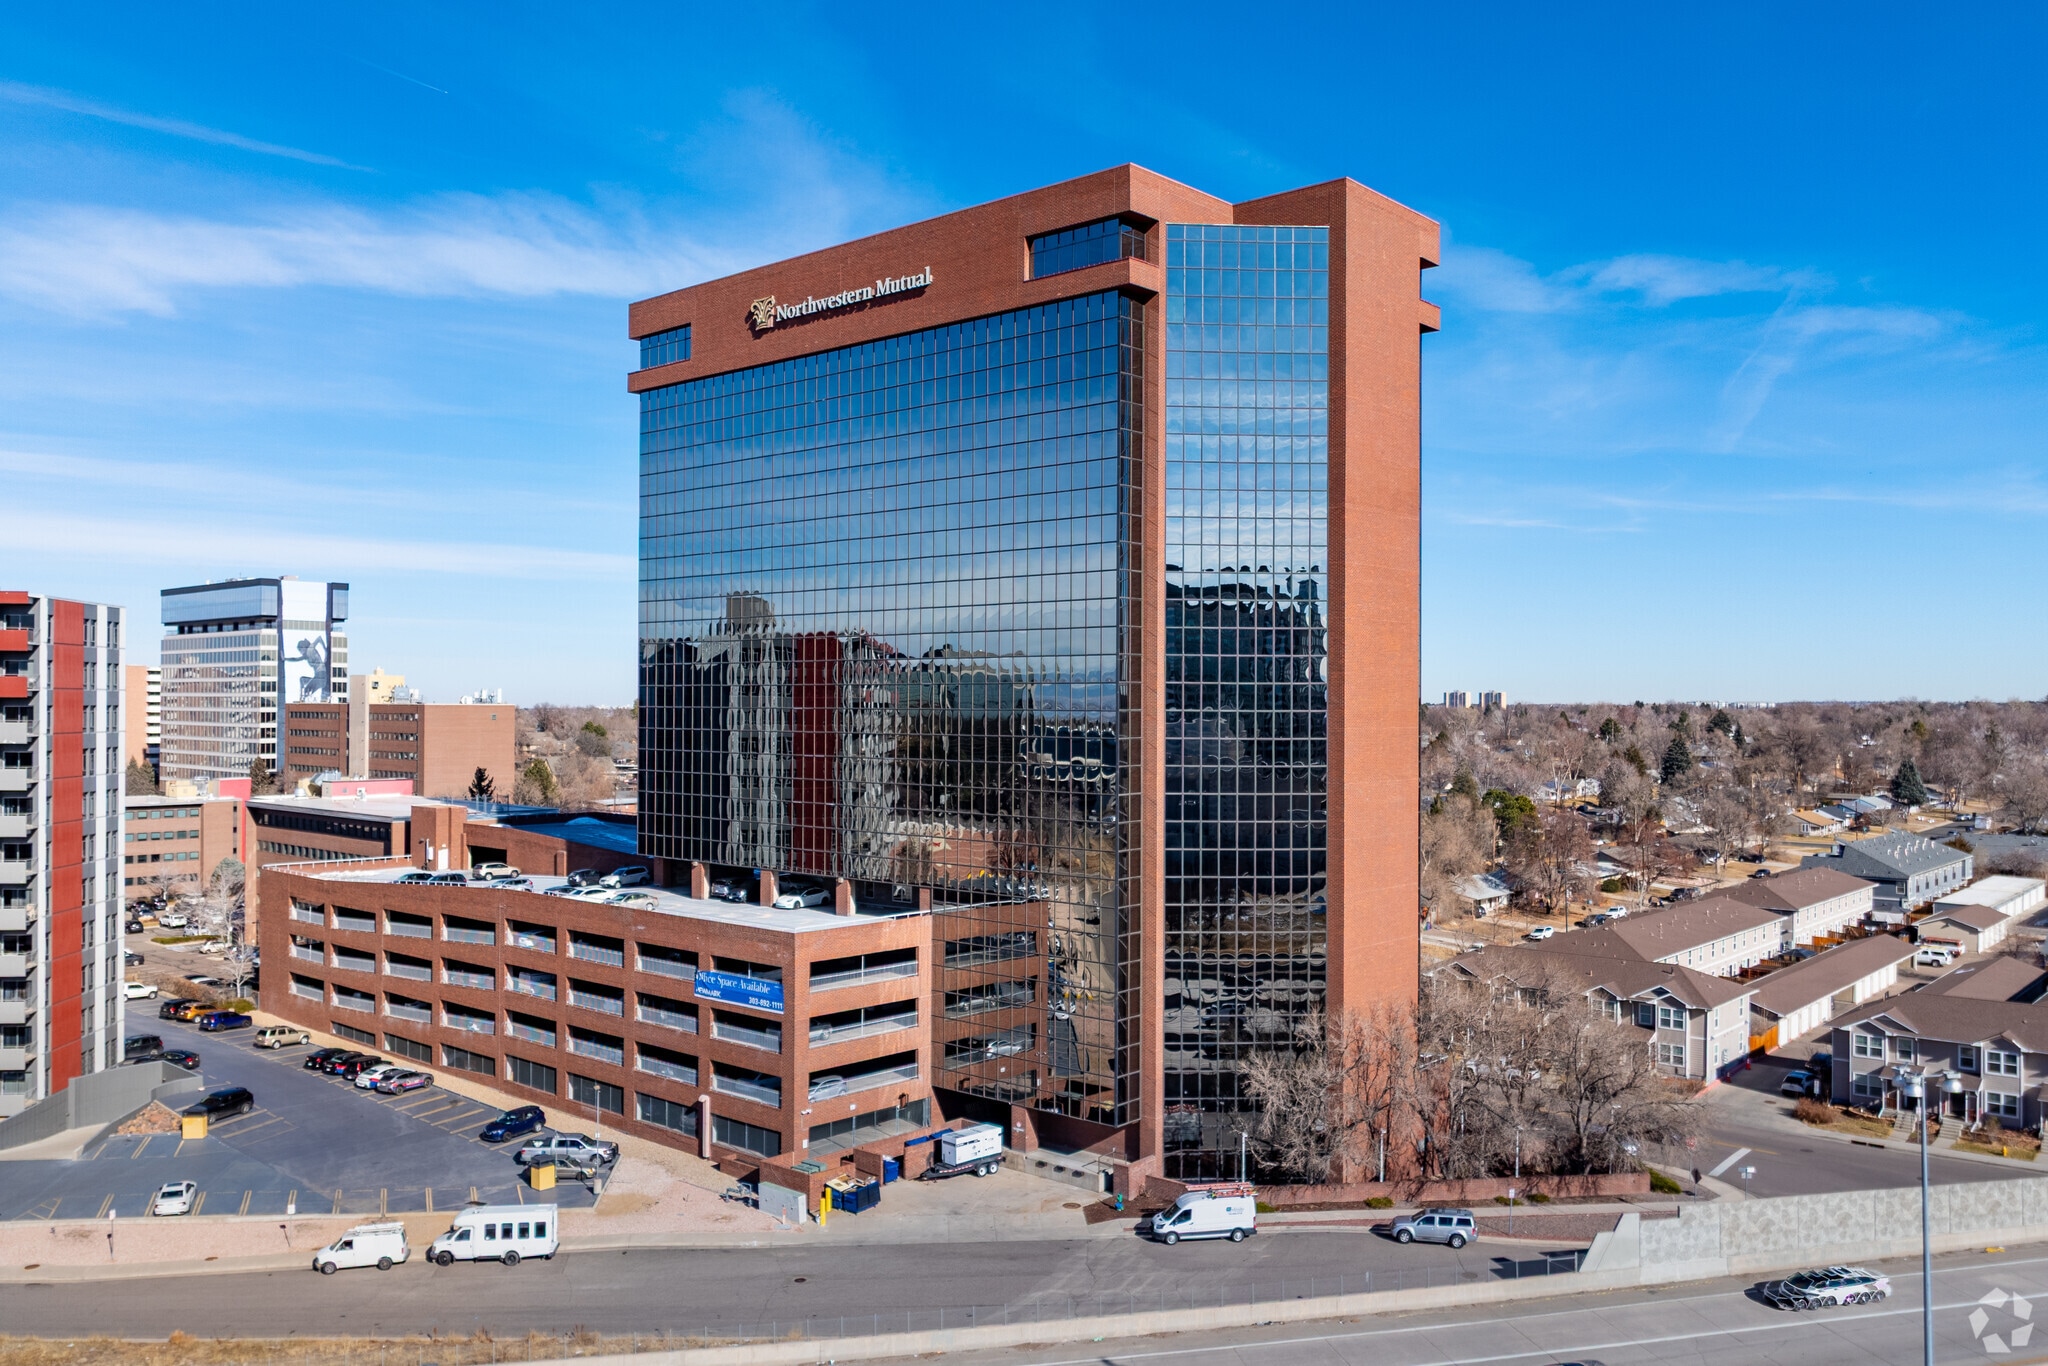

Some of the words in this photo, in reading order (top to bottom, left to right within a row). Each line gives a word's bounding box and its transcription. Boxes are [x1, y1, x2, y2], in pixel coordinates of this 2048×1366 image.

[776, 286, 873, 322] Northwestern
[875, 266, 932, 297] Mutual
[717, 975, 737, 988] Space
[738, 979, 771, 994] Available
